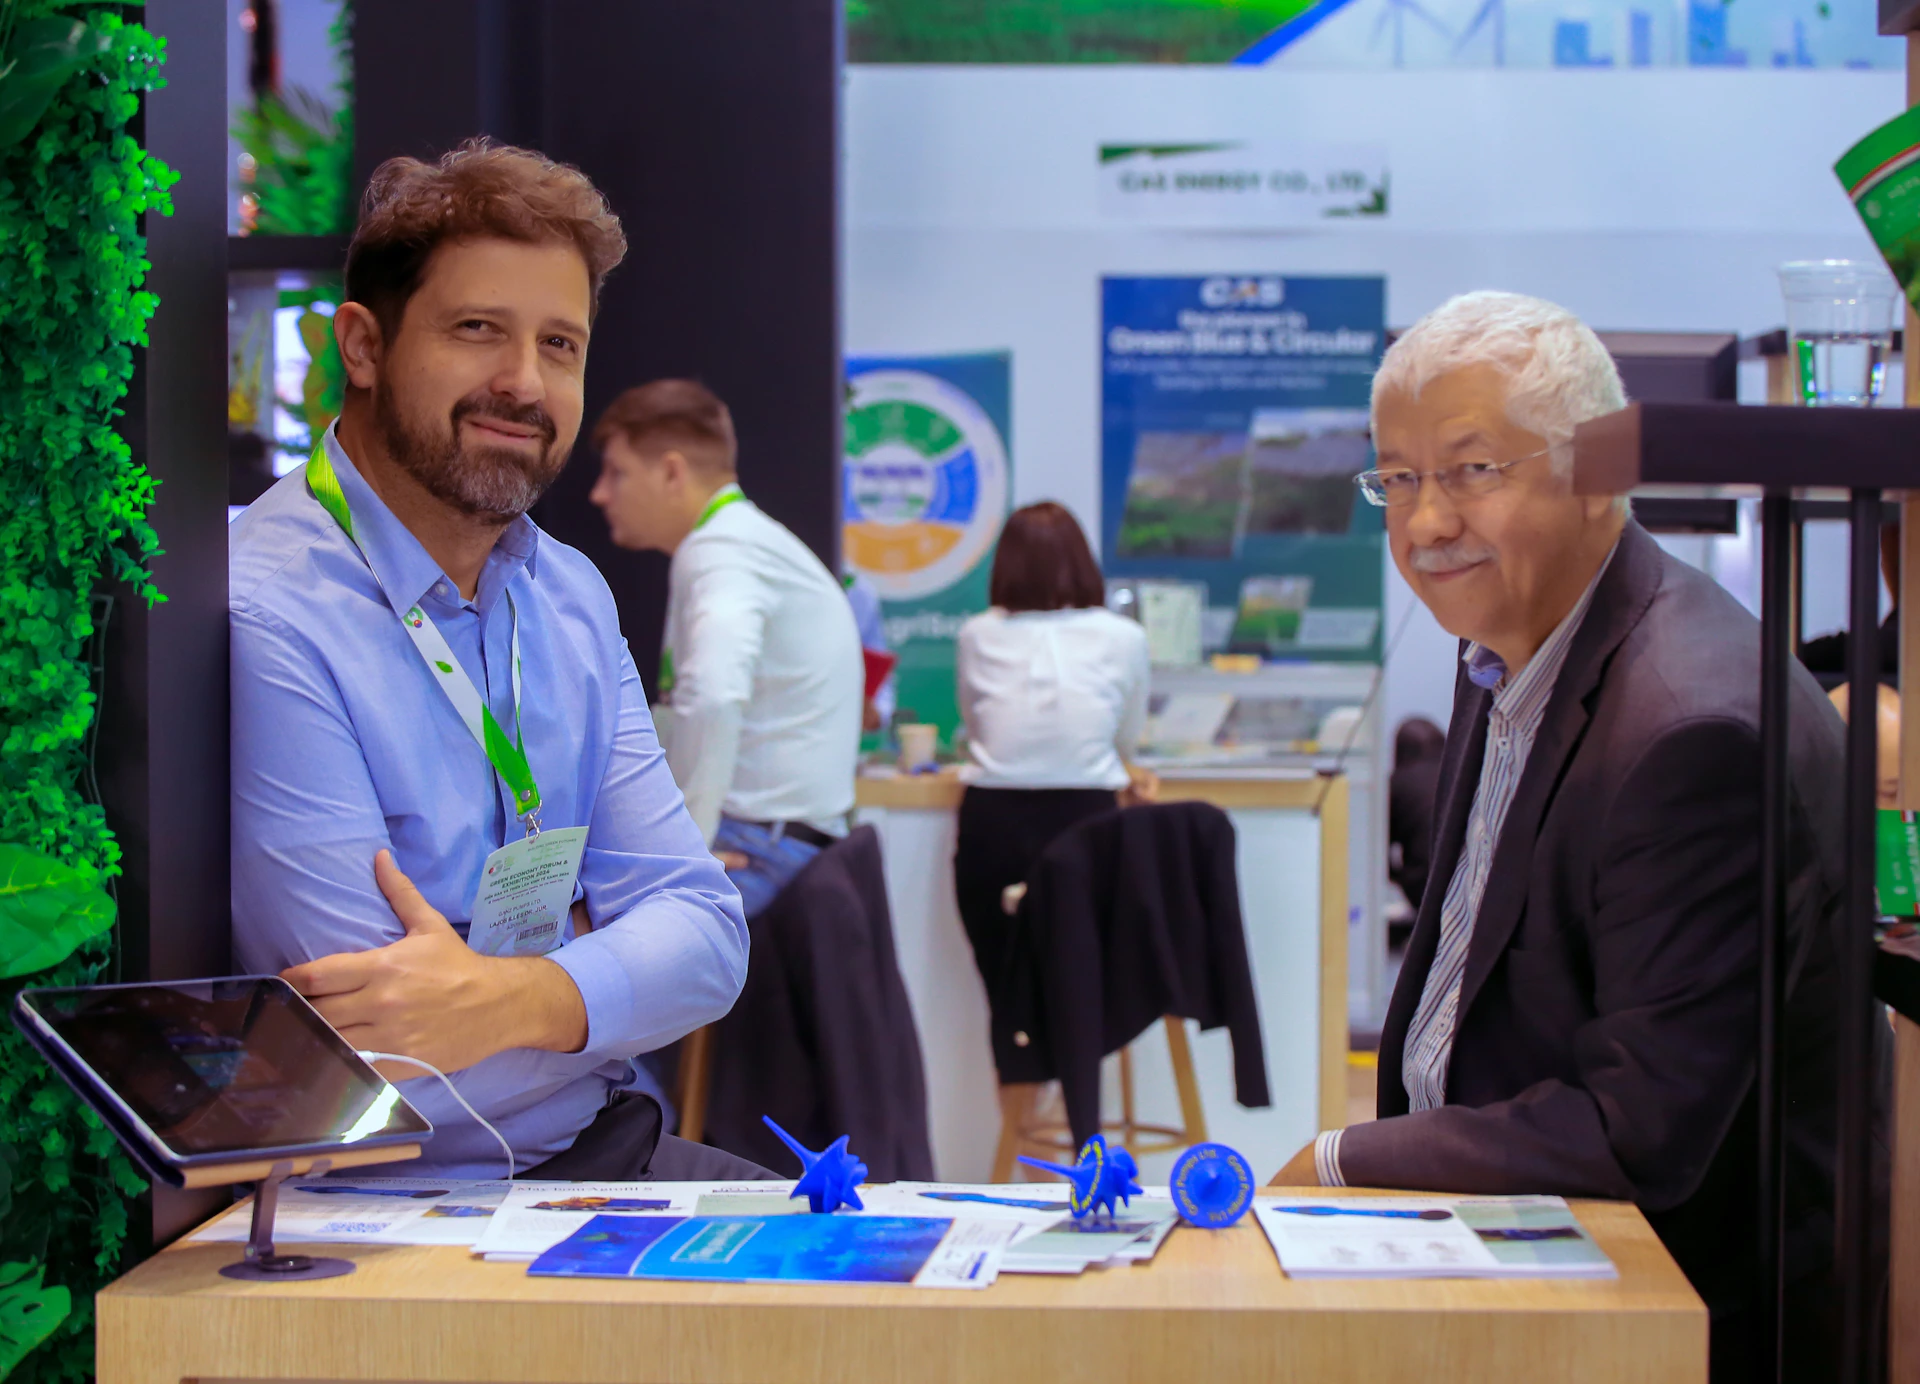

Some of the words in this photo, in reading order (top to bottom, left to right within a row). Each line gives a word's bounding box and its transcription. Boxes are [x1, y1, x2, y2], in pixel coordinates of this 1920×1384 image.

[1251, 328, 1270, 354] &
[490, 876, 509, 887] GREEN
[509, 866, 539, 880] ECONOMY
[539, 860, 563, 871] FORUM
[502, 874, 535, 889] EXHIBITION
[535, 869, 550, 878] 2024
